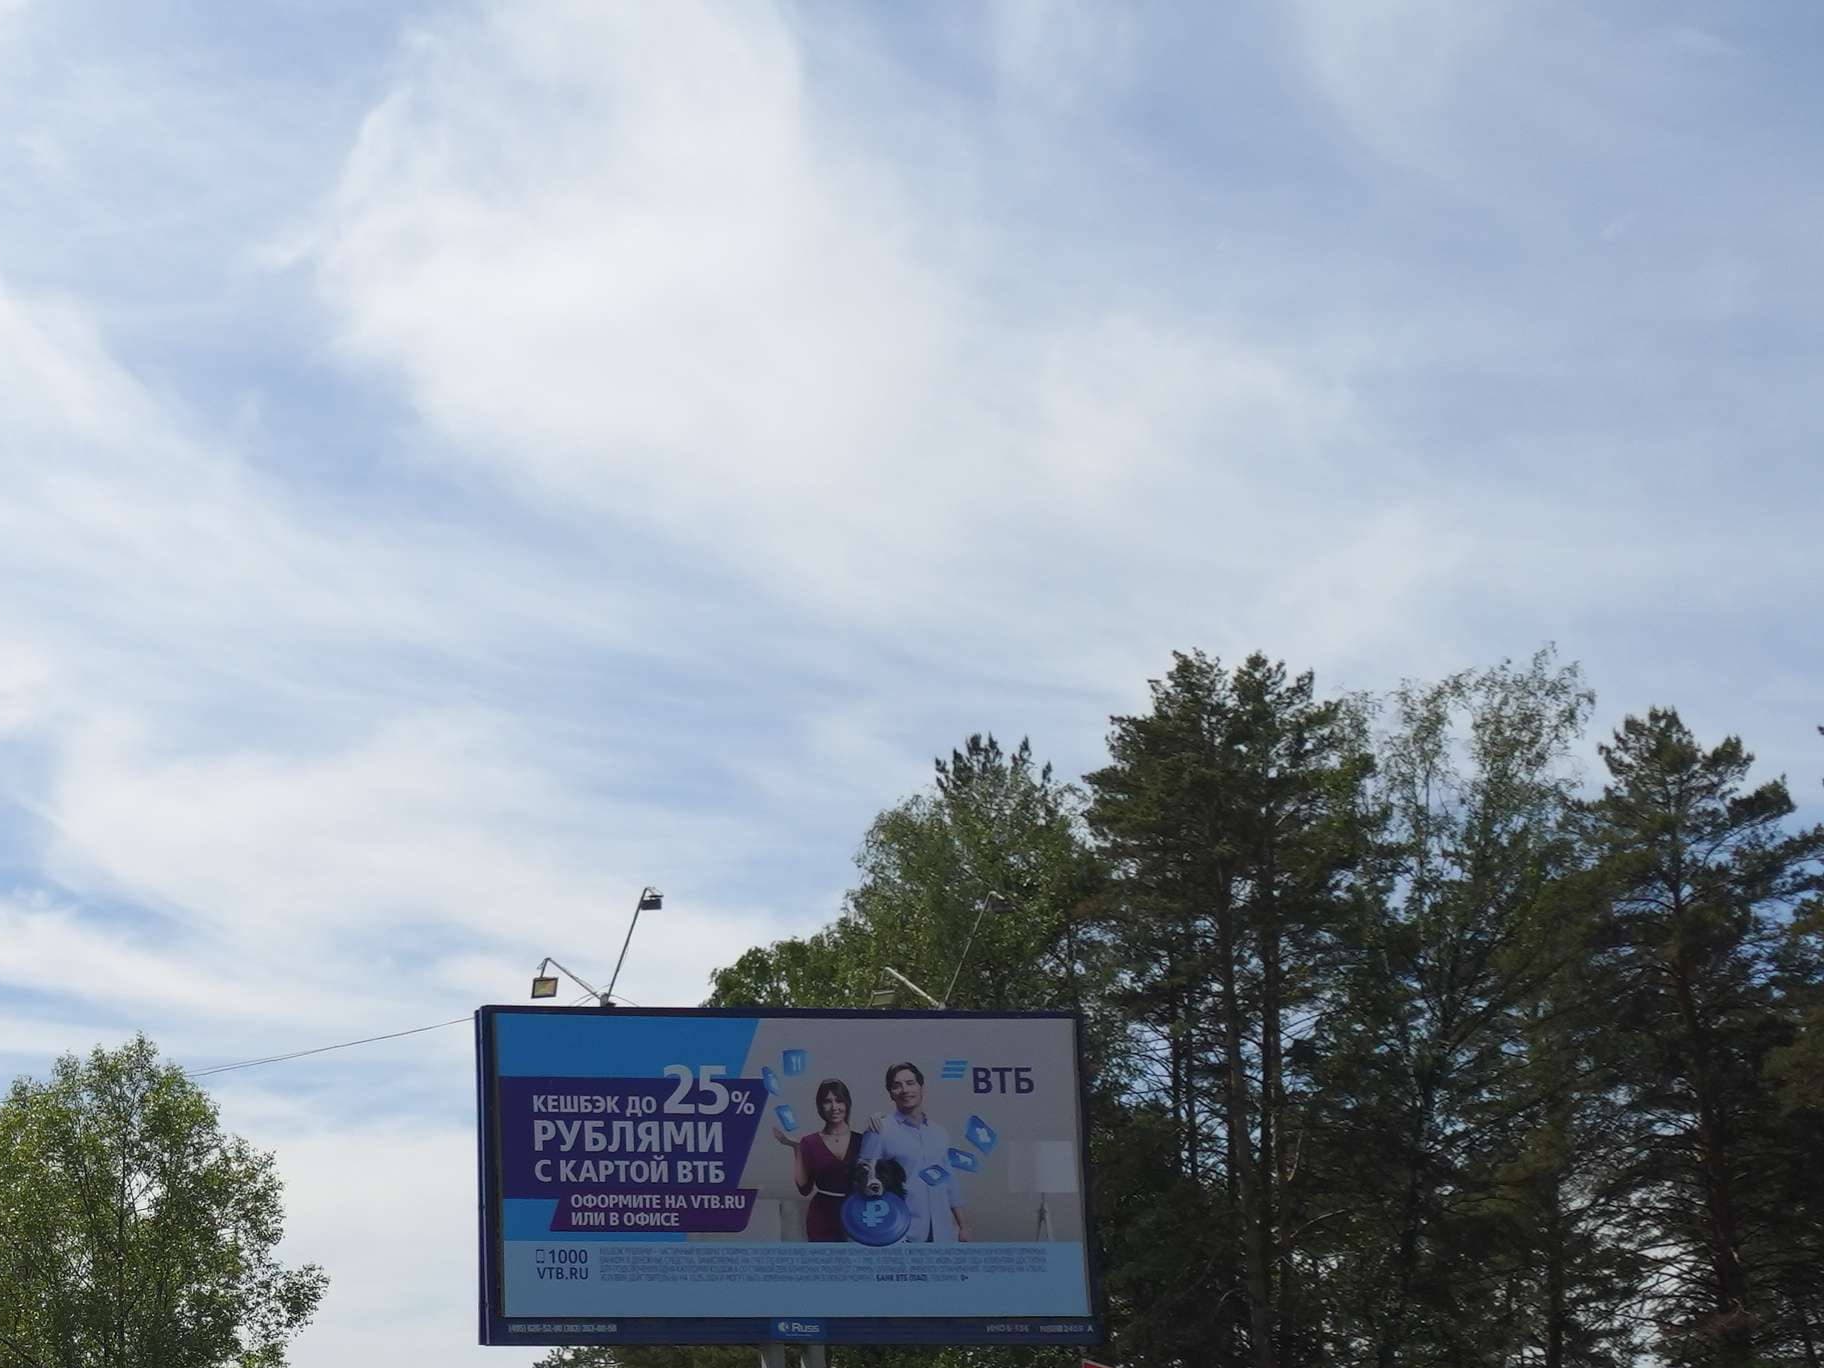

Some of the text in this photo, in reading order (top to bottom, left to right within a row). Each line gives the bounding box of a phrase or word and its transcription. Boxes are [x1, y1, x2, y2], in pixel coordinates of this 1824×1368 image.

[972, 1067, 1034, 1094] ВТБ
[532, 1064, 756, 1117] КЕШБЭК ДО 25%
[533, 1120, 724, 1153] РУБЛЯМИ
[534, 1155, 725, 1184] С КАРТОЙ ВТБ
[570, 1193, 746, 1209] ОФОРМИТЕ НА VTB.RU
[571, 1212, 680, 1227] ИЛИ В ОФИСЕ
[548, 1249, 589, 1264] 1000
[537, 1267, 589, 1281] VTB.RU
[791, 1322, 821, 1333] Russ
